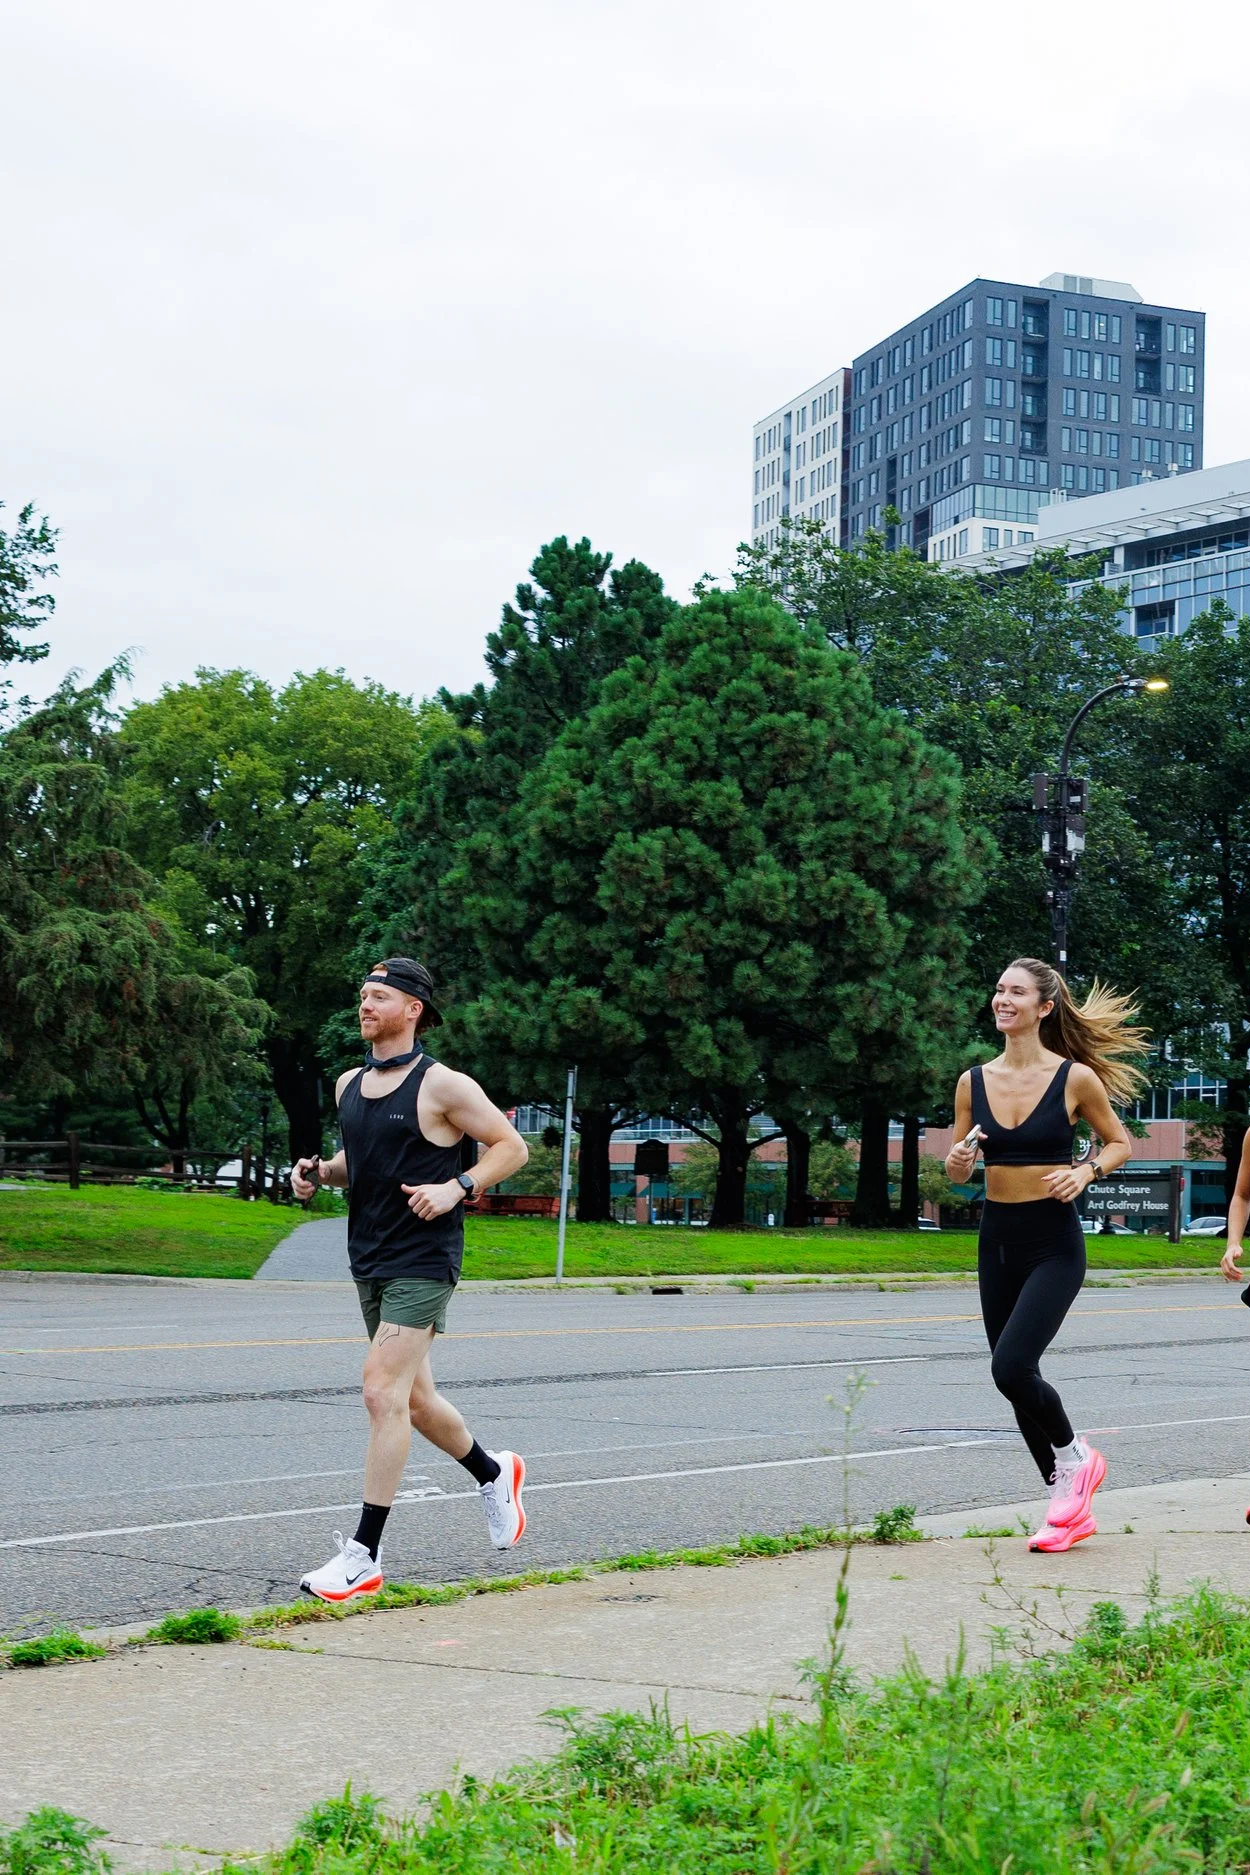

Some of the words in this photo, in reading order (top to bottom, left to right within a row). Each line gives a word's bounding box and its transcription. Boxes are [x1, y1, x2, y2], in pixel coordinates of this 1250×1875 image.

[1087, 1185, 1115, 1194] Chute
[1118, 1185, 1151, 1196] Square
[1087, 1201, 1105, 1210] Ard
[1106, 1200, 1140, 1212] Godfrey
[1143, 1201, 1169, 1210] House
